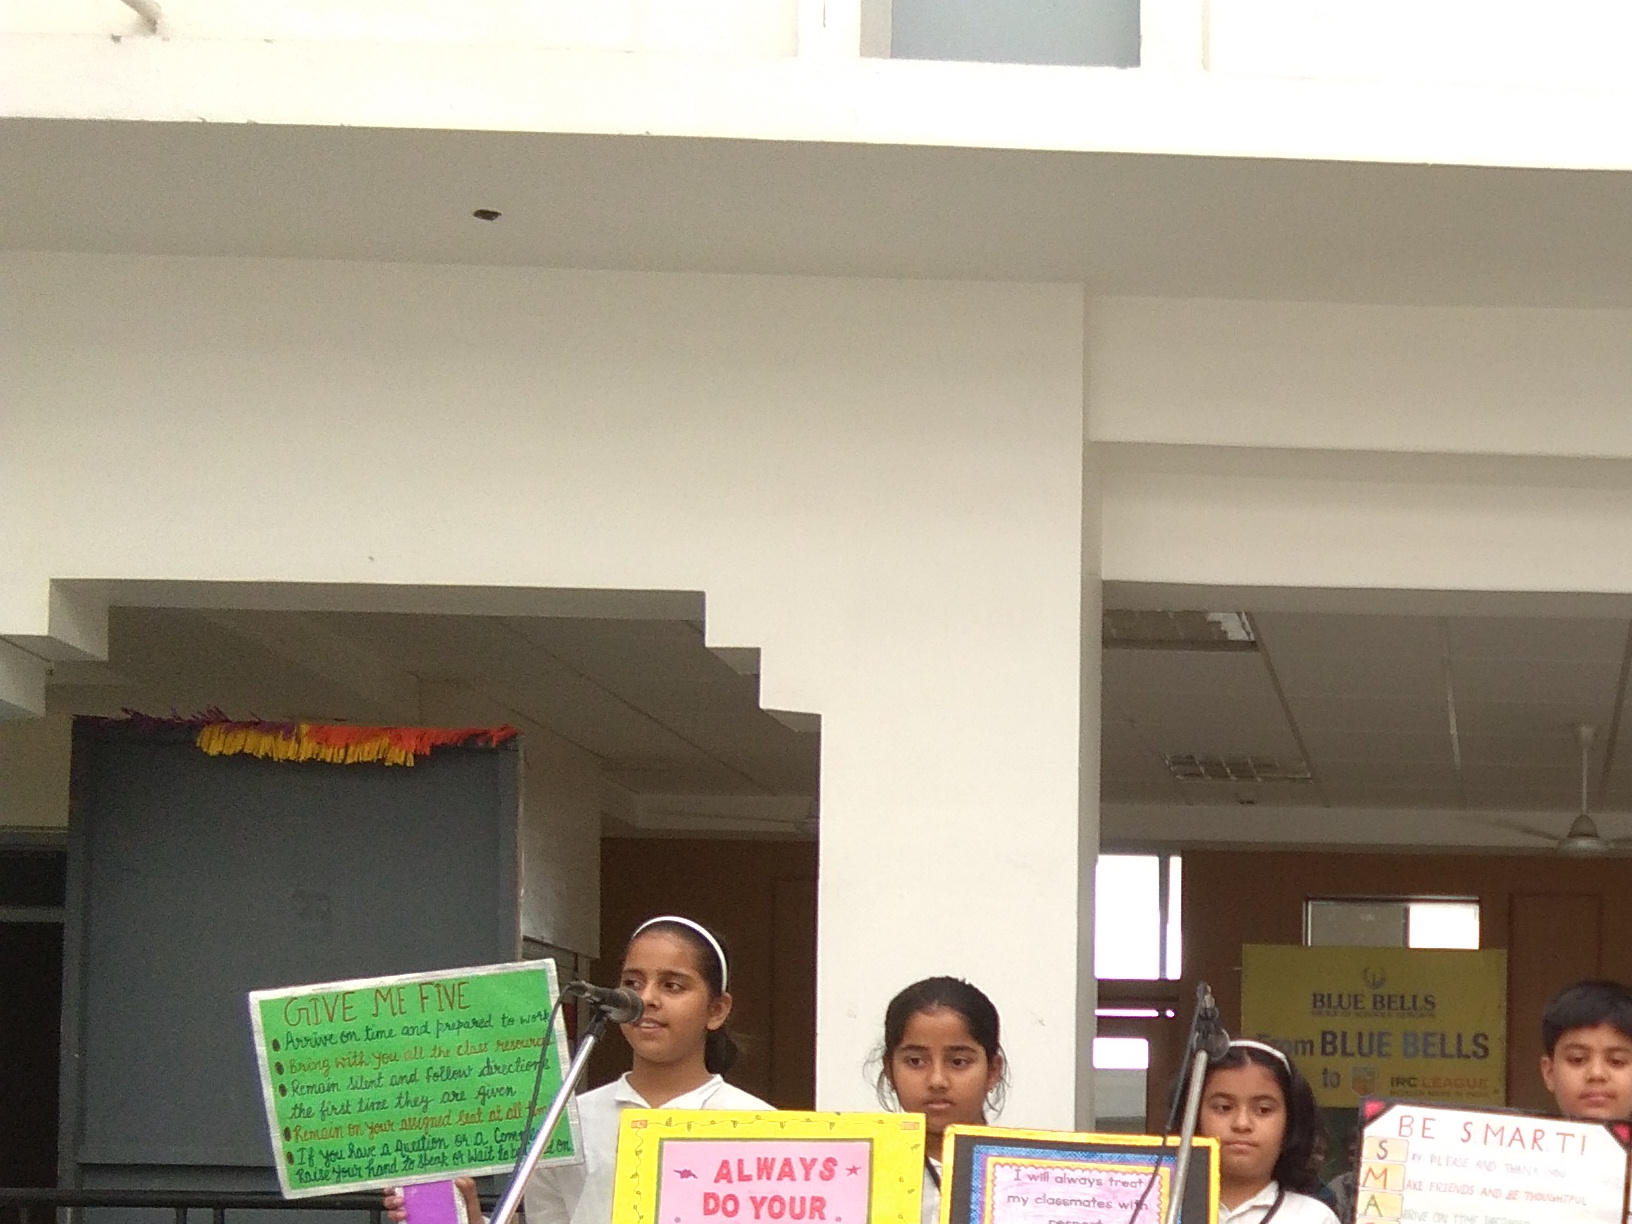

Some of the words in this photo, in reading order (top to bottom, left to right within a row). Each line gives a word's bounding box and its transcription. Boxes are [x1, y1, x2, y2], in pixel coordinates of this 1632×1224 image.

[284, 991, 358, 1027] GIVE
[372, 987, 407, 1018] ME
[418, 981, 471, 1013] FIVE
[1311, 992, 1366, 1011] BLUE
[1372, 993, 1436, 1012] BELLS
[285, 1030, 338, 1051] Arrive
[340, 1030, 361, 1044] on
[364, 1025, 397, 1042] time
[401, 1020, 431, 1037] and
[436, 1013, 494, 1039] prepared
[501, 1013, 515, 1028] to
[1321, 1030, 1393, 1058] BLUE
[1402, 1032, 1490, 1060] BELLS
[289, 1058, 331, 1078] Bring
[335, 1051, 370, 1068] with
[372, 1051, 399, 1071] you
[403, 1046, 426, 1060] all
[290, 1077, 341, 1097] Remain
[389, 1068, 419, 1087] and
[1322, 1067, 1341, 1088] to
[289, 1102, 315, 1120] the
[319, 1099, 352, 1122] first
[356, 1095, 389, 1113] time
[394, 1091, 435, 1113] they
[440, 1089, 467, 1104] are
[474, 1084, 517, 1106] given
[293, 1122, 344, 1143] Remain
[365, 1120, 396, 1141] your
[505, 1102, 523, 1120] all
[1398, 1114, 1437, 1140] BE
[296, 1147, 315, 1168] If
[319, 1148, 344, 1168] you
[347, 1143, 377, 1159] have
[454, 1133, 469, 1147] or
[1376, 1139, 1389, 1161] S
[1429, 1153, 1471, 1168] PLEASE
[332, 1164, 363, 1183] your
[365, 1156, 400, 1178] hand
[452, 1150, 465, 1166] or
[714, 1156, 839, 1184] ALWAYS
[1014, 1168, 1022, 1182] I
[1027, 1171, 1050, 1183] will
[1054, 1172, 1103, 1188] always
[1108, 1176, 1144, 1189] treat
[1361, 1166, 1389, 1190] M
[1429, 1181, 1475, 1196] FRIENDS
[1480, 1187, 1503, 1199] AND
[1524, 1190, 1587, 1206] THOUGHTFUL
[703, 1191, 740, 1218] DO
[749, 1195, 827, 1220] YOUR
[1006, 1194, 1029, 1207] my
[1034, 1193, 1113, 1209] classmates
[1364, 1193, 1383, 1218] A
